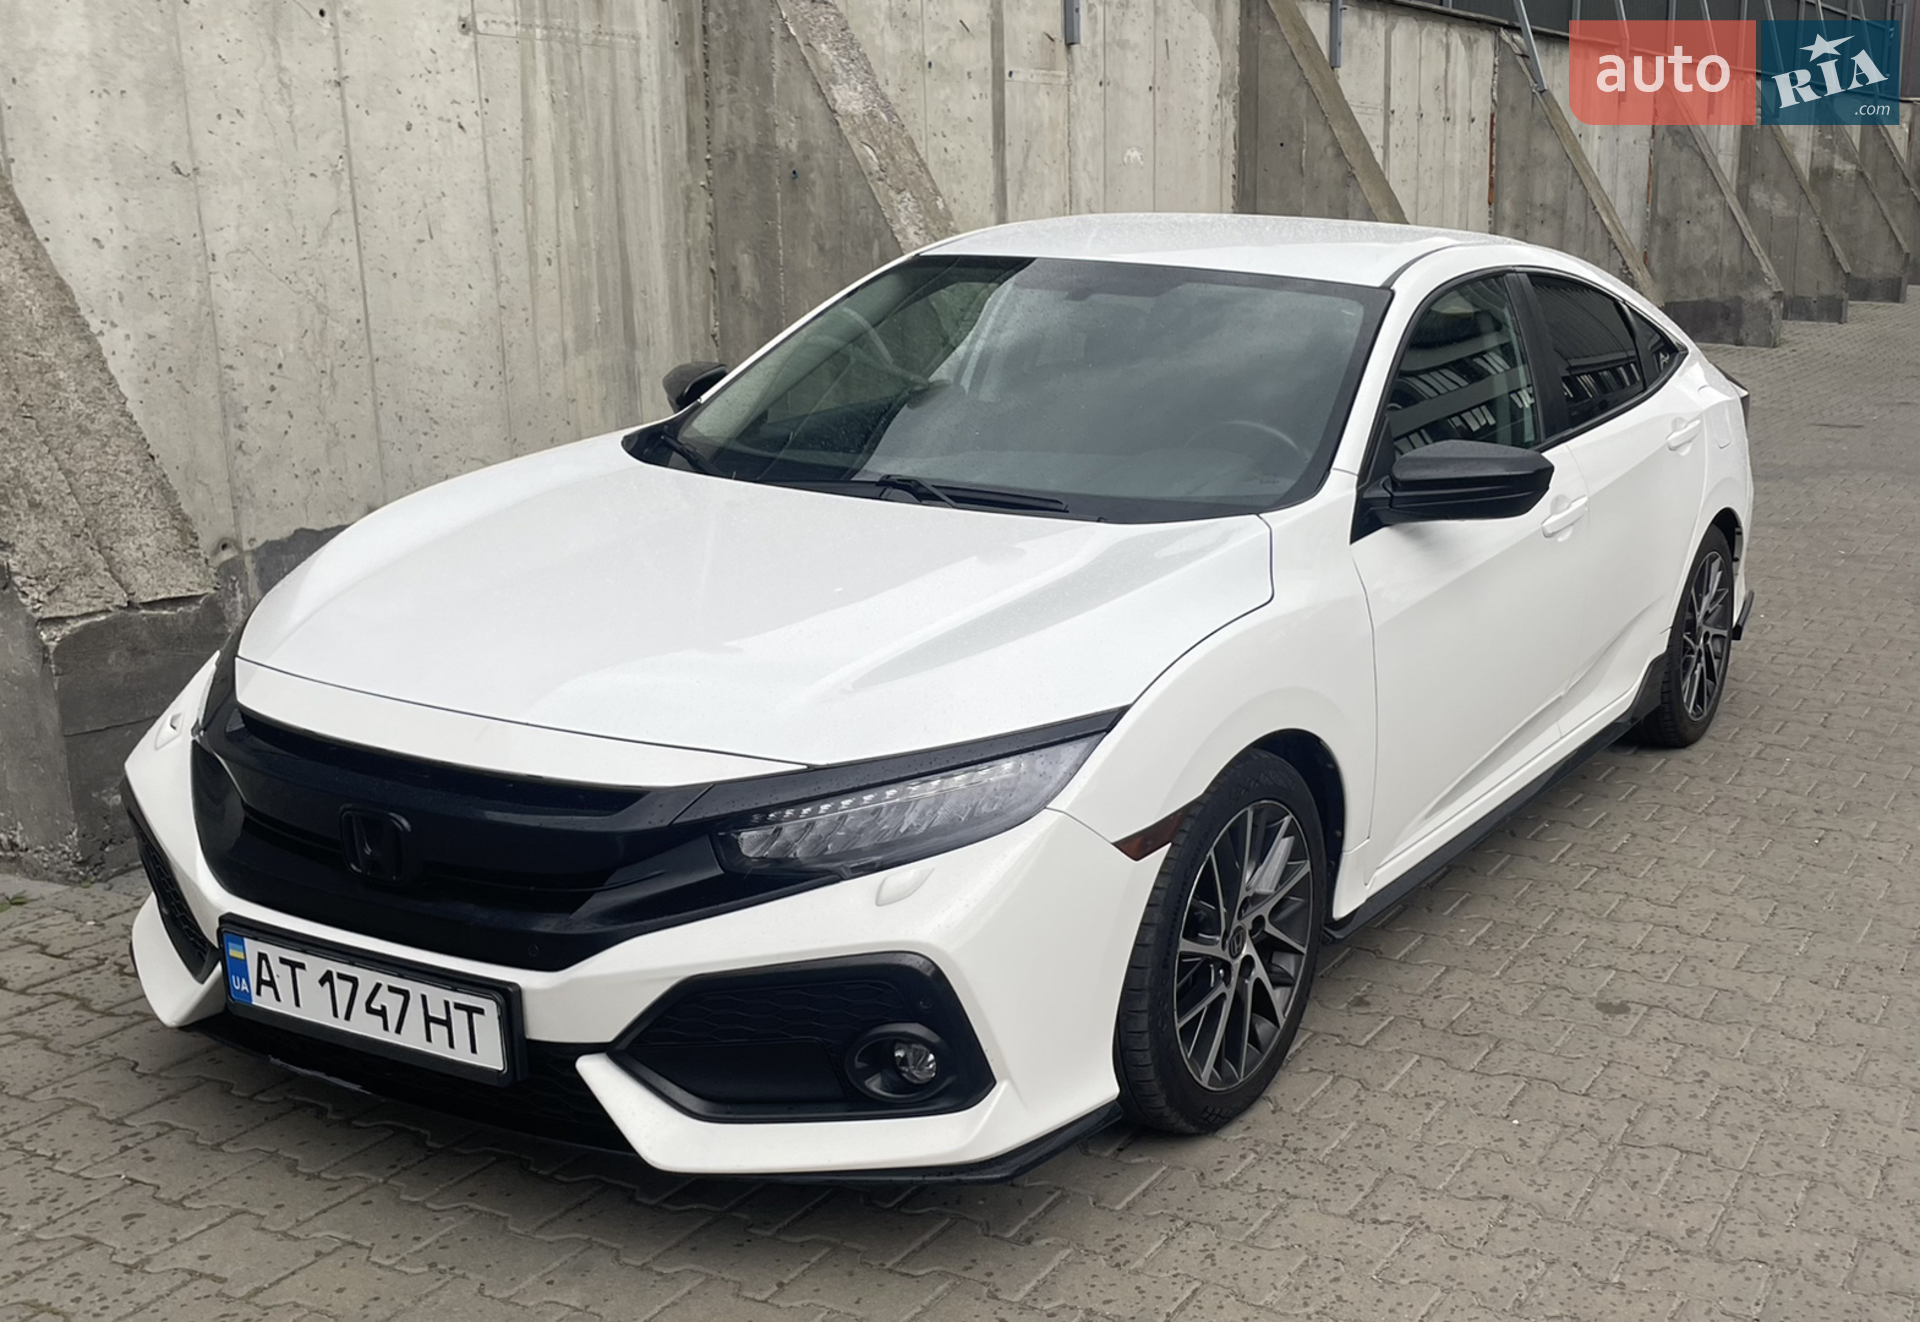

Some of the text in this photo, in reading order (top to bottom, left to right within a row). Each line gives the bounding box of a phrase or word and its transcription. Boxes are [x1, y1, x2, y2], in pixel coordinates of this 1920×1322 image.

[231, 974, 250, 994] UA
[255, 950, 486, 1055] AT 1747 HT
